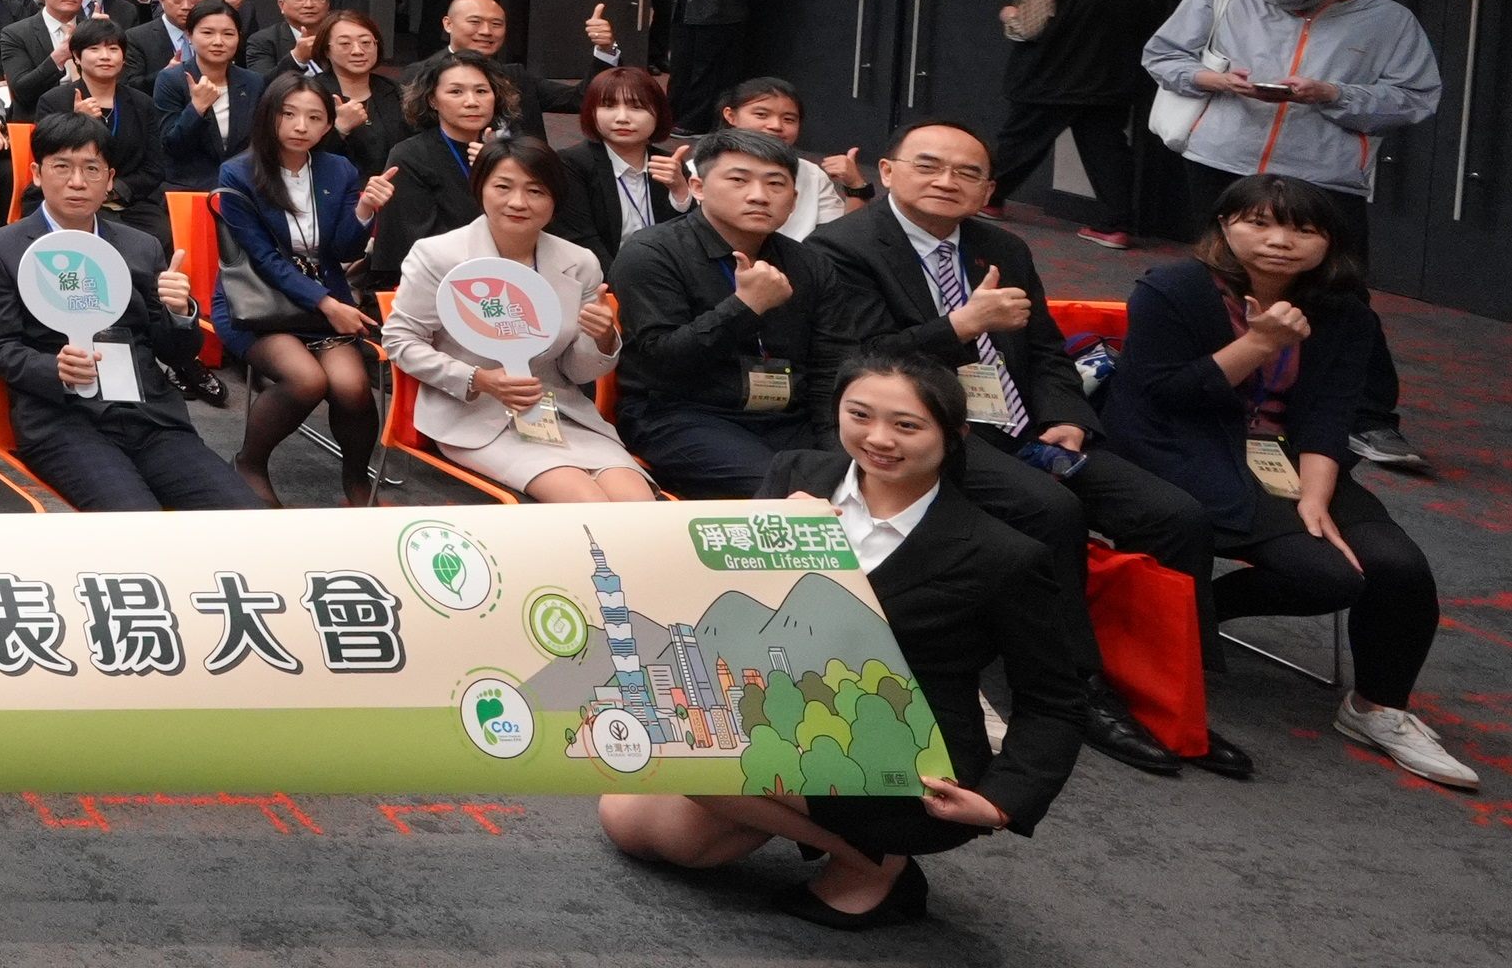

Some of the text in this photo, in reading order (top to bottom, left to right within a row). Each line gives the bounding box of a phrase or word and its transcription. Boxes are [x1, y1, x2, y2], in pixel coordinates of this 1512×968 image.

[58, 271, 97, 292] 綠色
[480, 298, 525, 318] 綠色
[695, 514, 850, 553] 淨零綠生活
[724, 553, 840, 570] Green Lifestyle
